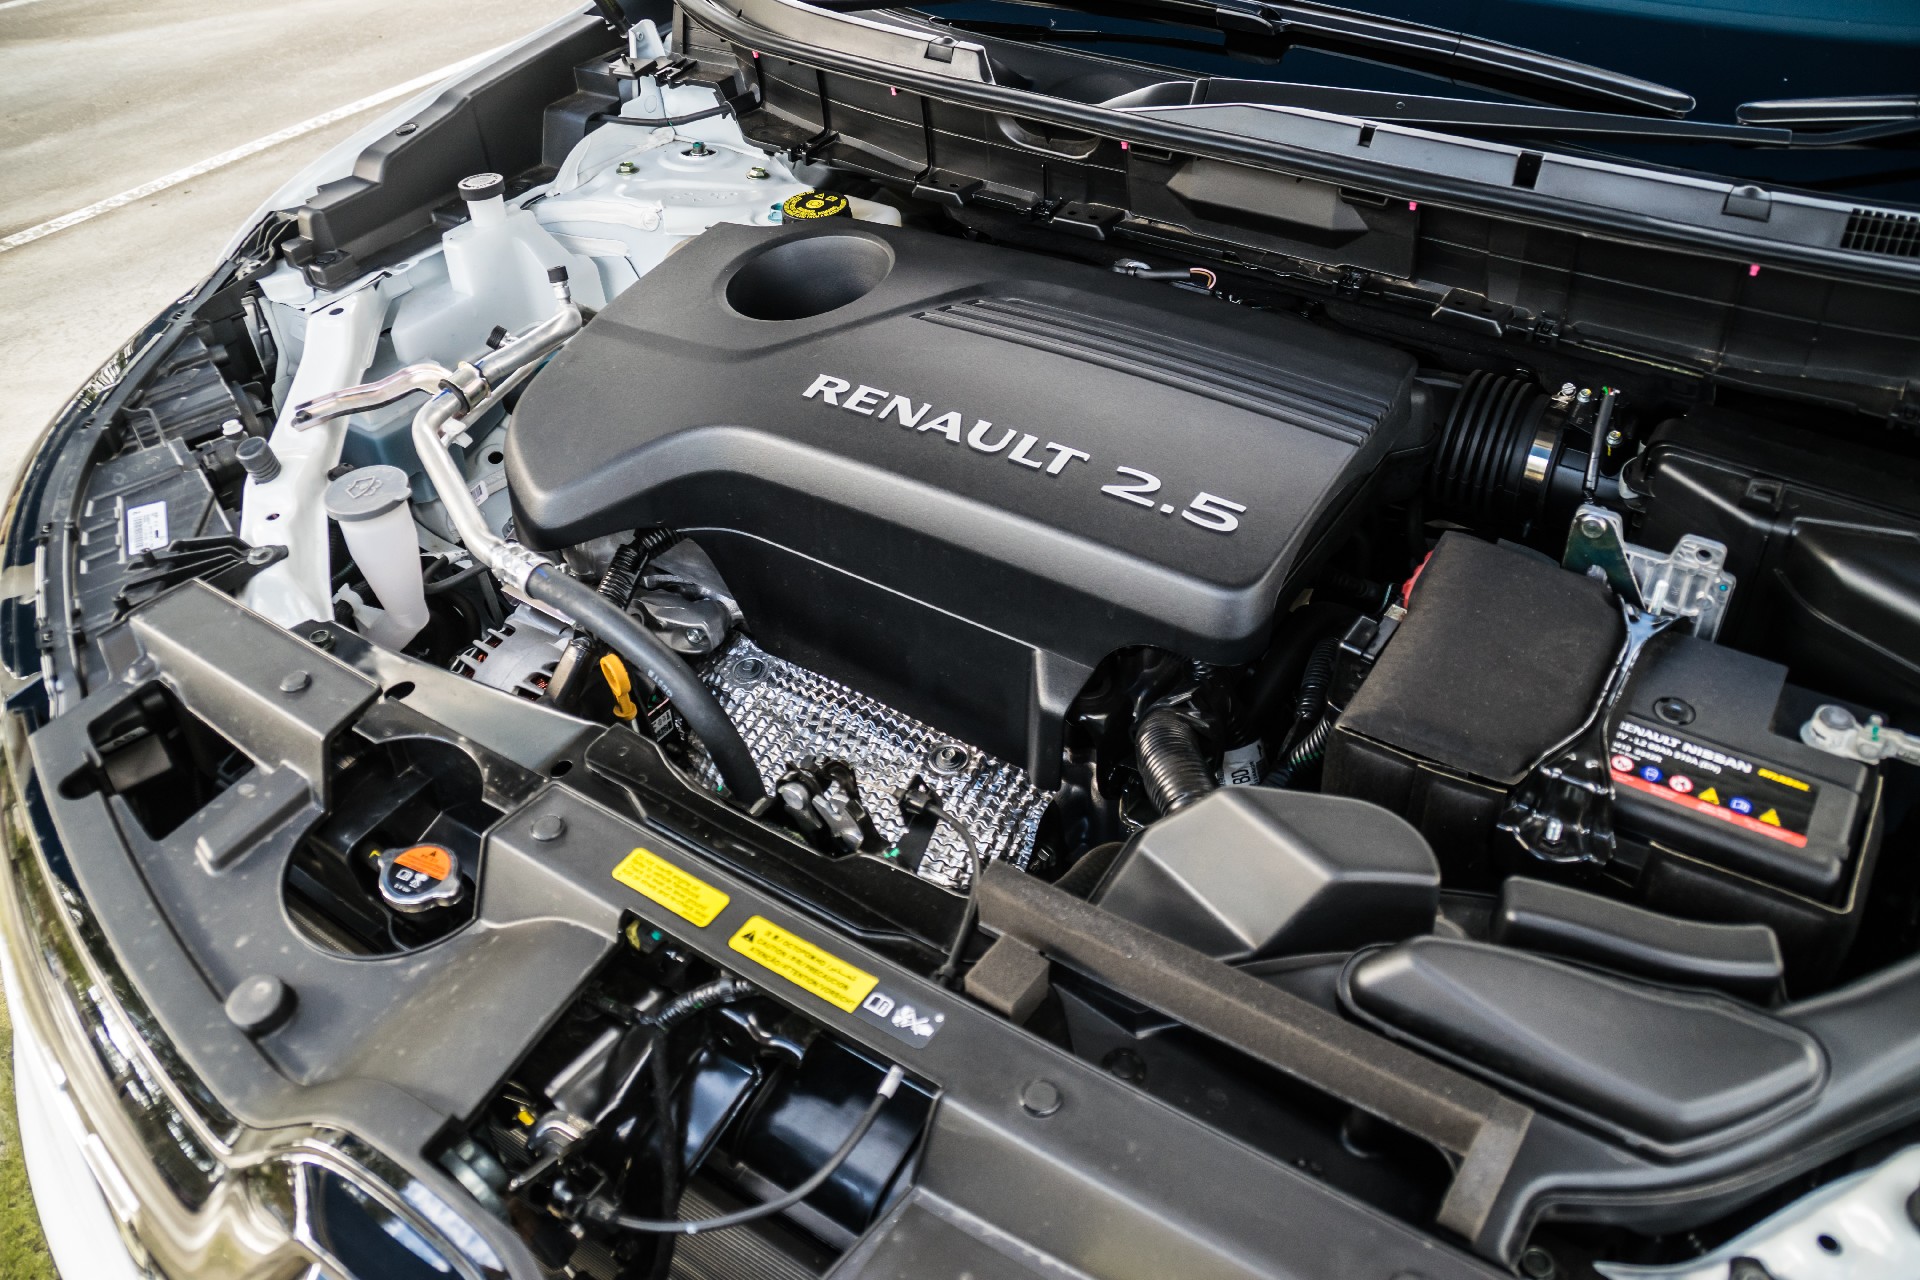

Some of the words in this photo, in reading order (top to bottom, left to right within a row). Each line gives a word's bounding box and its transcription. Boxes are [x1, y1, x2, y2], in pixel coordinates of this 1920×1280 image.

[801, 373, 1091, 475] RENAULT
[1100, 465, 1247, 533] 2.5
[1681, 742, 1752, 773] NISSAN
